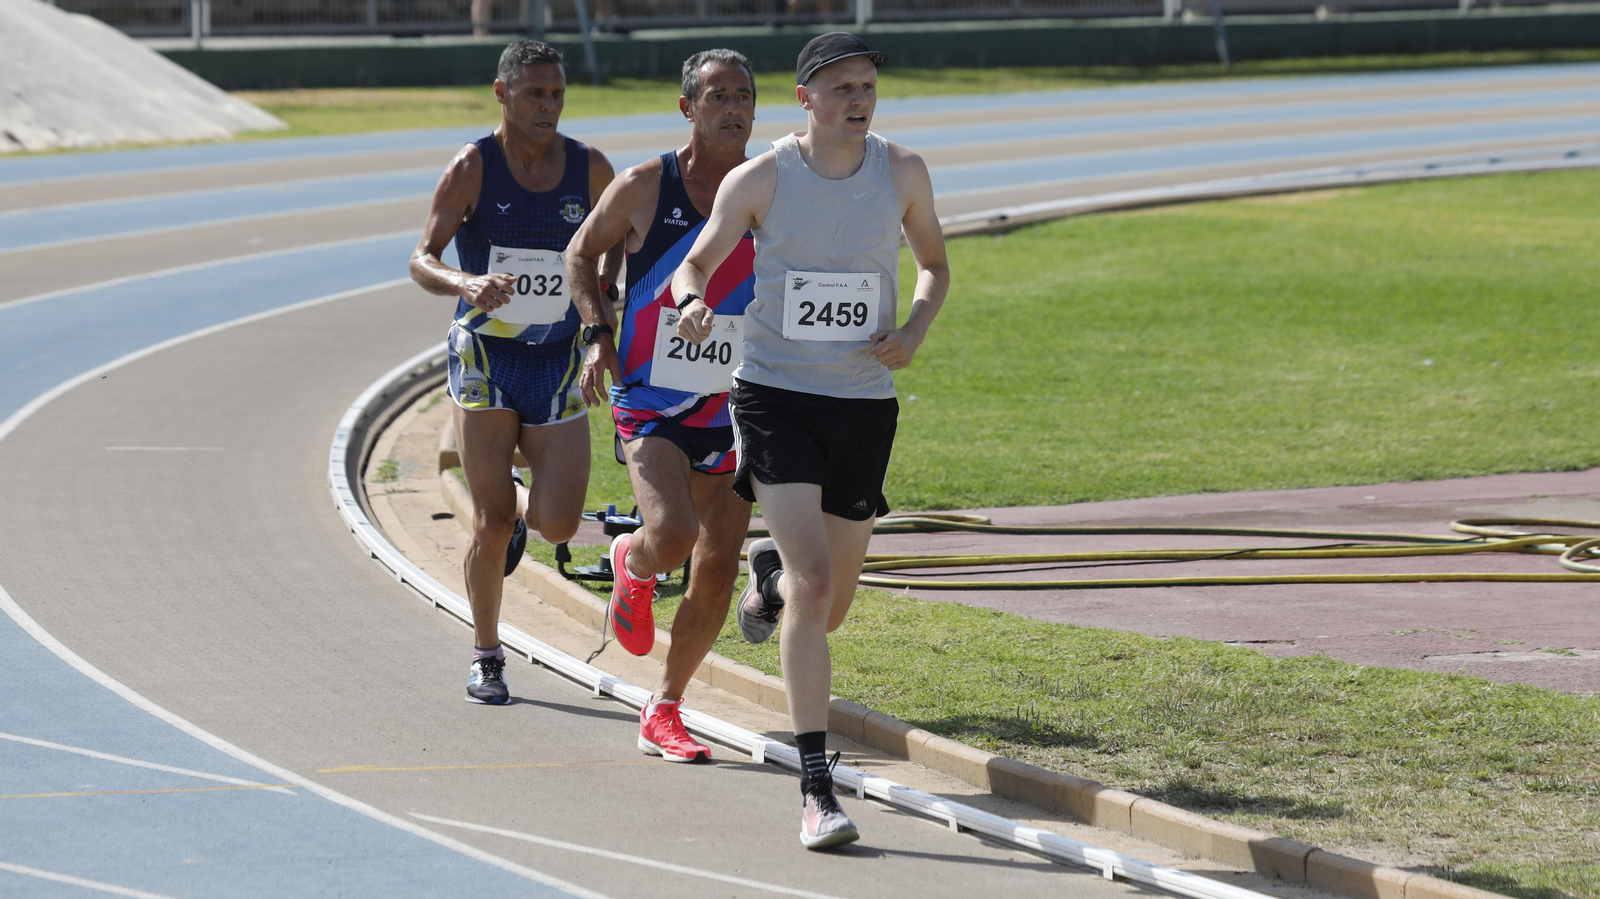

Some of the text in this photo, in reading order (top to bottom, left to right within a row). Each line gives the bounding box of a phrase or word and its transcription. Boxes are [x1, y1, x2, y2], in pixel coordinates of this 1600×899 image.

[664, 218, 689, 227] VIATOR
[504, 272, 563, 296] 032
[798, 301, 868, 327] 2459
[667, 336, 732, 365] 2040
